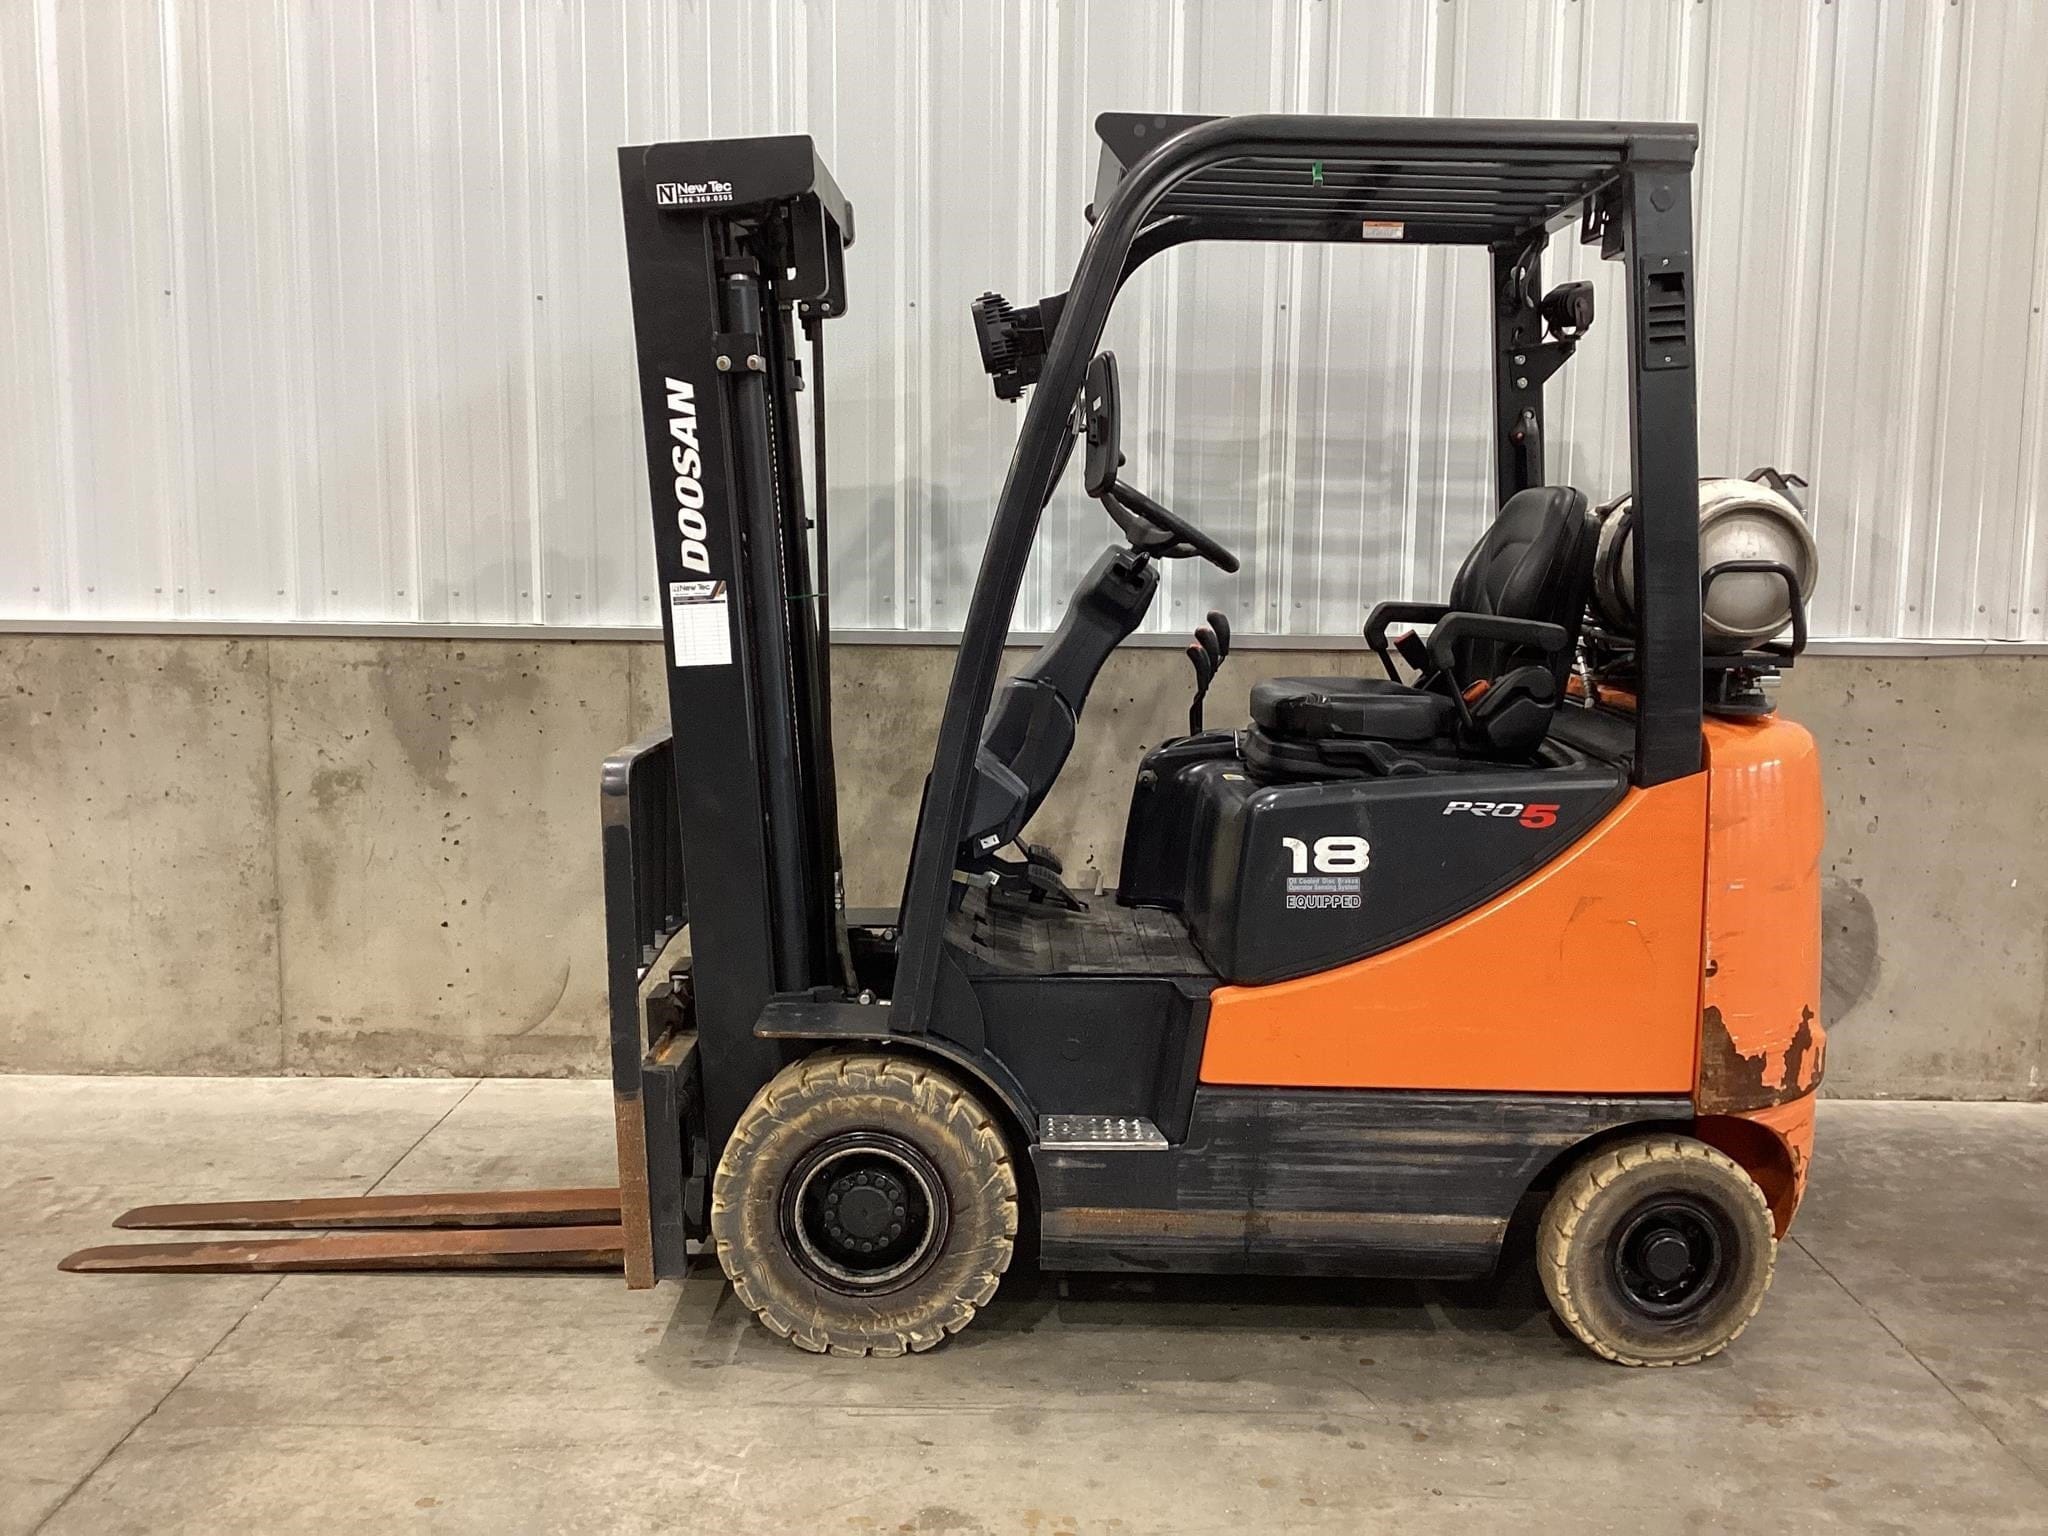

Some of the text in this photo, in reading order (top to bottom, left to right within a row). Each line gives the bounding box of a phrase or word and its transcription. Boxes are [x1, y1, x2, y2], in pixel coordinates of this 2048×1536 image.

[677, 182, 707, 194] New
[708, 181, 732, 192] Tec
[665, 376, 710, 574] DOOSAN
[680, 584, 696, 592] New
[697, 583, 711, 591] Tec
[1283, 836, 1370, 873] 18
[1286, 895, 1361, 909] EQUIPPED
